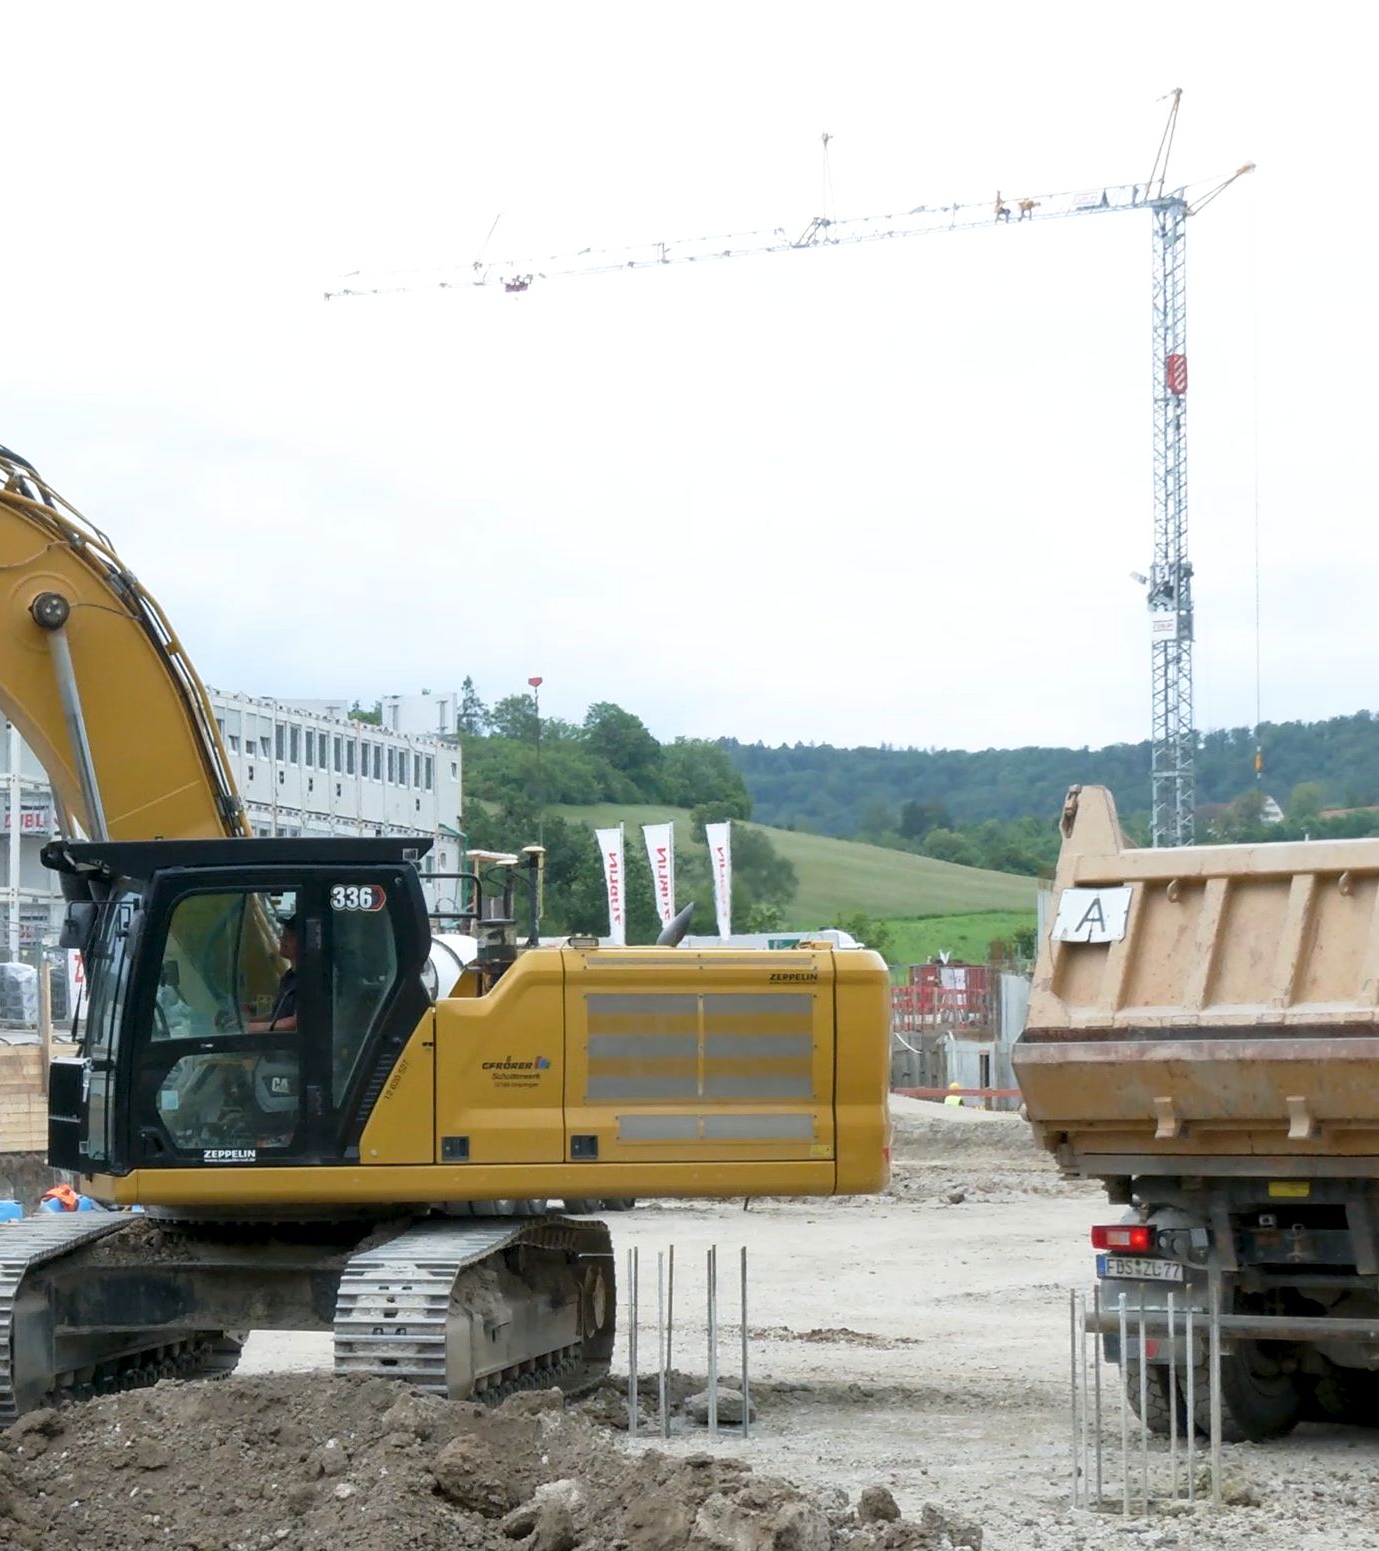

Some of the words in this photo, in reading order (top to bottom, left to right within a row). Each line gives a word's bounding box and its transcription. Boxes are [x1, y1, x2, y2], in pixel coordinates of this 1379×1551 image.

[332, 886, 373, 909] 336
[1075, 896, 1108, 933] A
[770, 973, 818, 981] ZEPPELIN
[482, 1055, 533, 1070] GFRÖRER
[203, 1149, 257, 1158] ZEPPELIN
